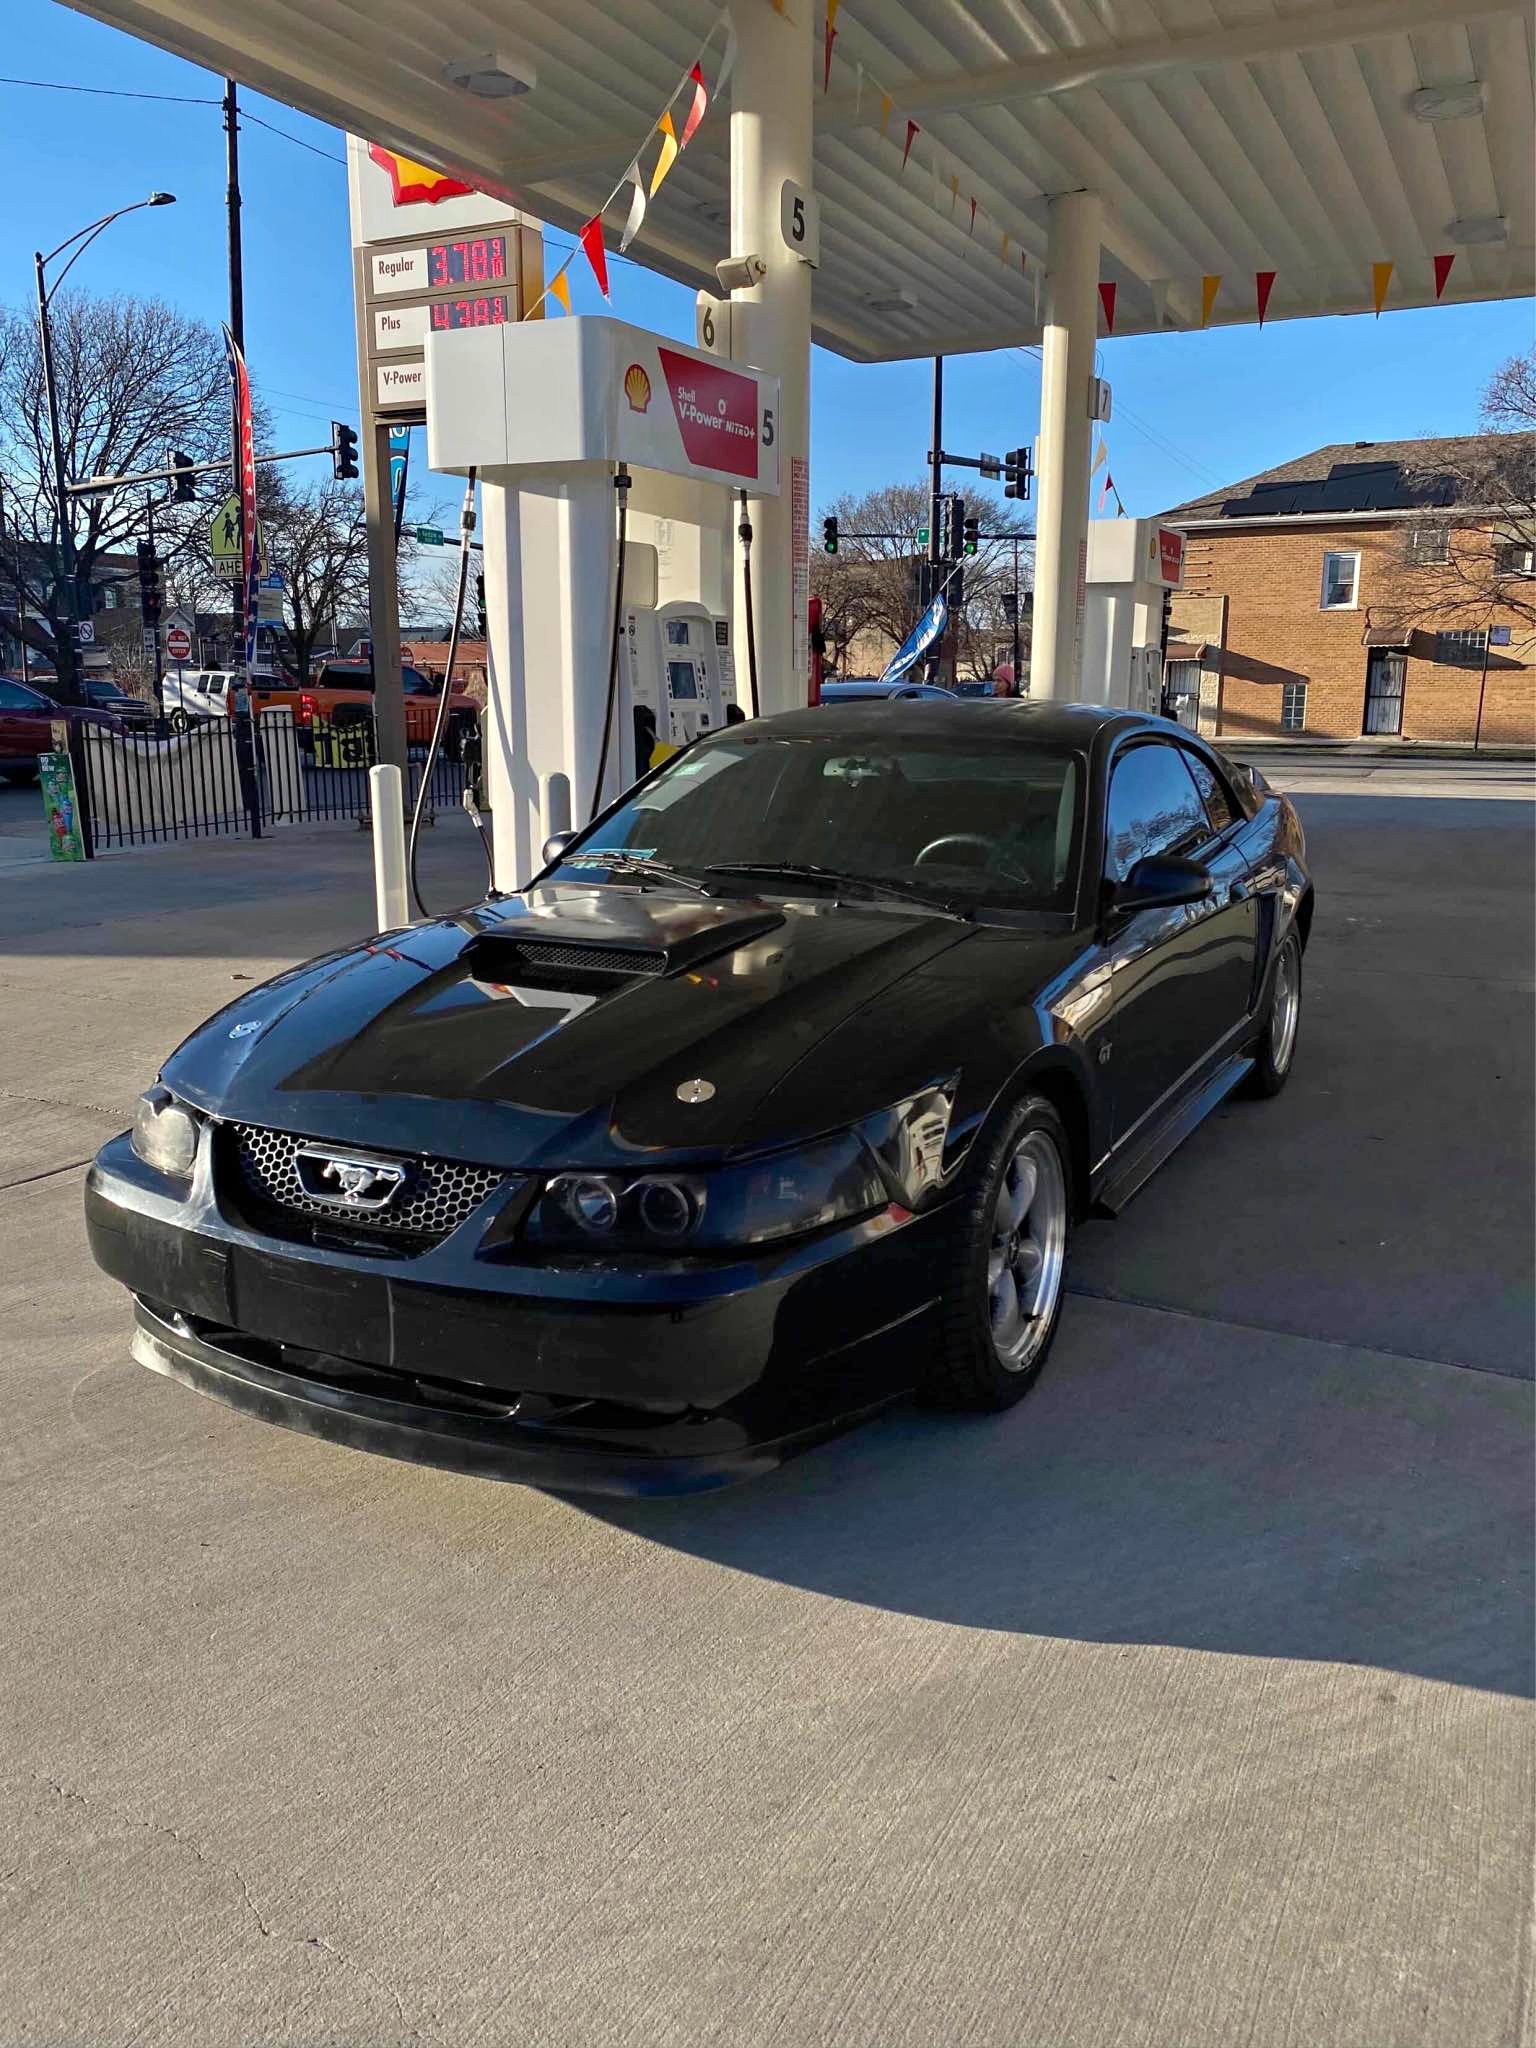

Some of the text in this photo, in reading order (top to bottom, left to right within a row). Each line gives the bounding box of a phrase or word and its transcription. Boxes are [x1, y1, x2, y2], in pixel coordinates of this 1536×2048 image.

[793, 196, 805, 242] 5
[378, 257, 414, 277] Regular
[431, 239, 488, 287] 3.78
[381, 315, 401, 332] Plus
[703, 307, 715, 347] 6
[383, 371, 422, 386] V-Power
[677, 386, 696, 403] Shell
[1102, 389, 1109, 413] 7
[678, 401, 722, 430] V-Power
[761, 408, 774, 447] 5
[219, 561, 263, 574] AHE
